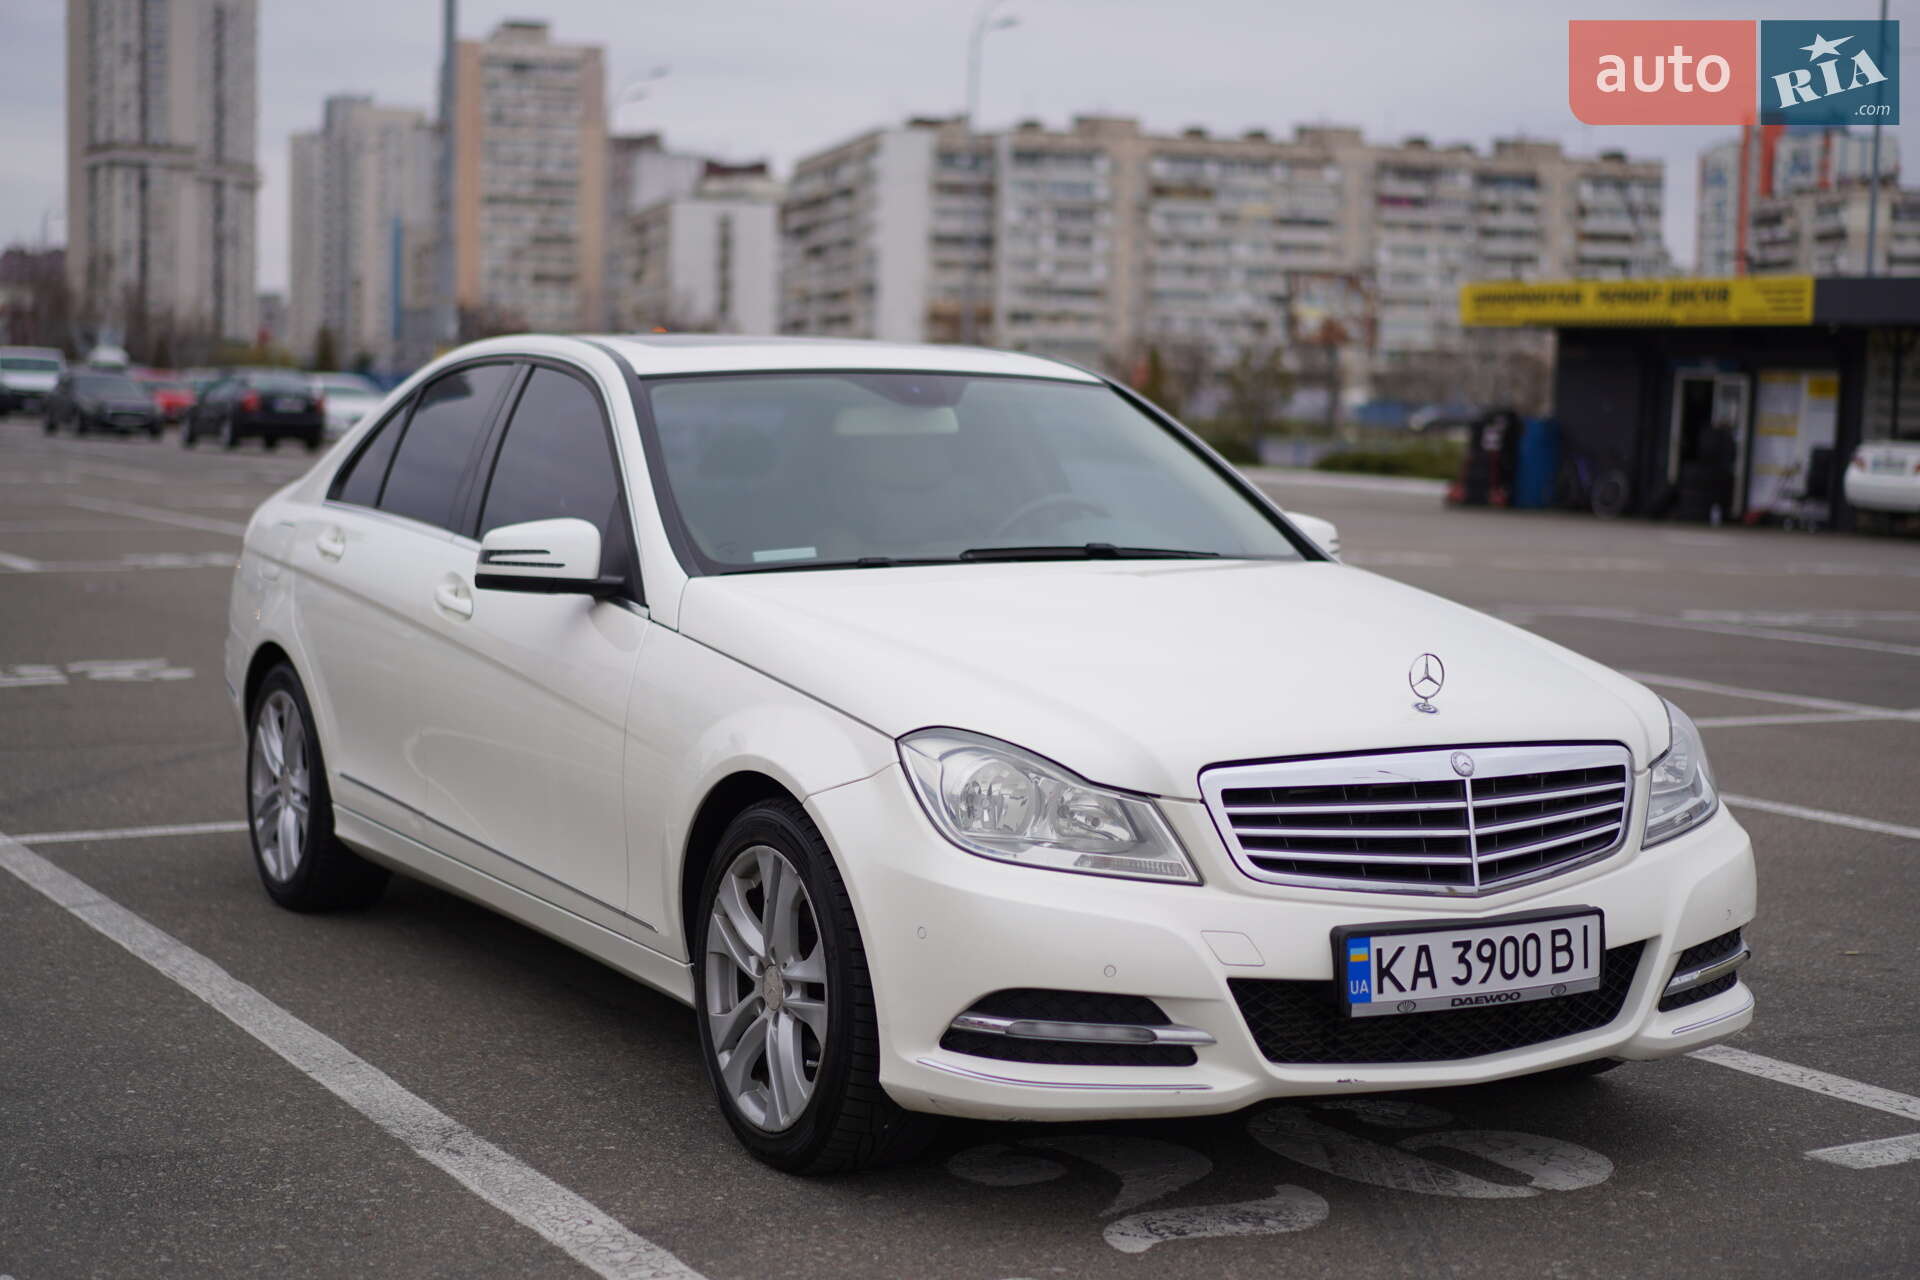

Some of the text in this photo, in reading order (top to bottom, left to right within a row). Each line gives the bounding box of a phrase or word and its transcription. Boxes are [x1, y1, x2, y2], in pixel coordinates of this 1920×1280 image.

[1376, 924, 1589, 994] KA 3900 BI
[1350, 980, 1369, 995] UA
[1450, 991, 1521, 1008] DAEWOO
